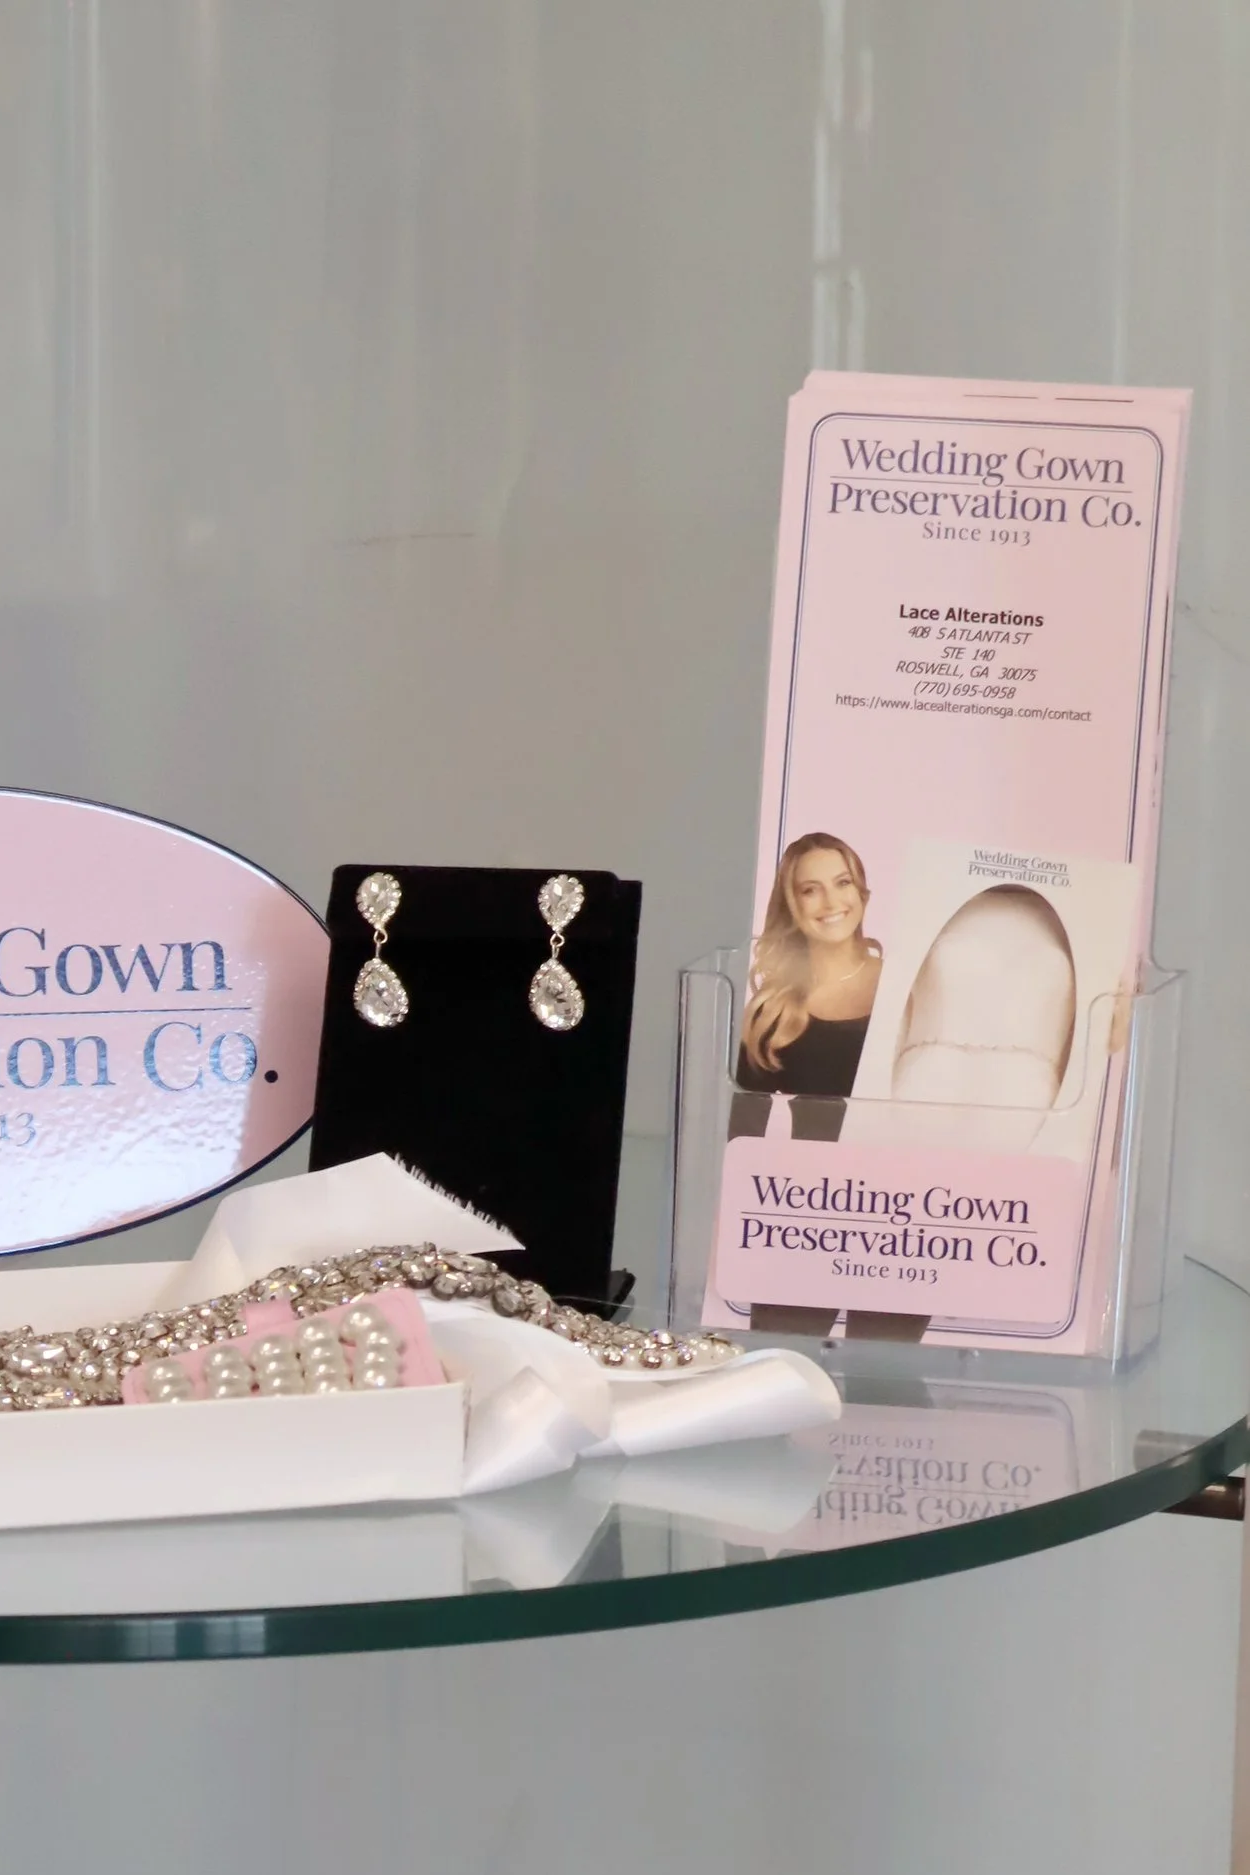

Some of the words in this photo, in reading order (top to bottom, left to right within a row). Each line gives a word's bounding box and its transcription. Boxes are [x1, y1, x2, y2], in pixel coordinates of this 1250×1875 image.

[840, 438, 1007, 487] Wedding
[1016, 447, 1125, 484] Gown
[827, 482, 1068, 523] Preservation
[1081, 495, 1142, 528] Co.
[922, 522, 982, 542] Since
[989, 529, 1032, 547] 1913
[899, 604, 940, 621] Lace
[944, 607, 1045, 628] Alterations
[908, 625, 932, 639] 408
[941, 646, 966, 660] STE
[971, 648, 996, 662] 140
[895, 661, 965, 680] ROSWELL,
[969, 665, 990, 679] GA
[998, 667, 1039, 682] 30075
[913, 680, 952, 698] (770)
[953, 683, 1017, 700] 695-0958
[835, 693, 1092, 722] https://www.lacealterationsga.com/contact
[973, 849, 1030, 869] Wedding
[1031, 857, 1069, 873] Gown
[967, 863, 1048, 884] Preservation
[1050, 874, 1072, 888] Co.
[142, 1020, 279, 1094] Co.
[751, 1175, 915, 1226] Wedding
[923, 1186, 1030, 1225] Gown
[738, 1217, 974, 1262] Preservation
[986, 1234, 1047, 1268] Co.
[831, 1258, 890, 1280] Since
[897, 1265, 939, 1285] 1913
